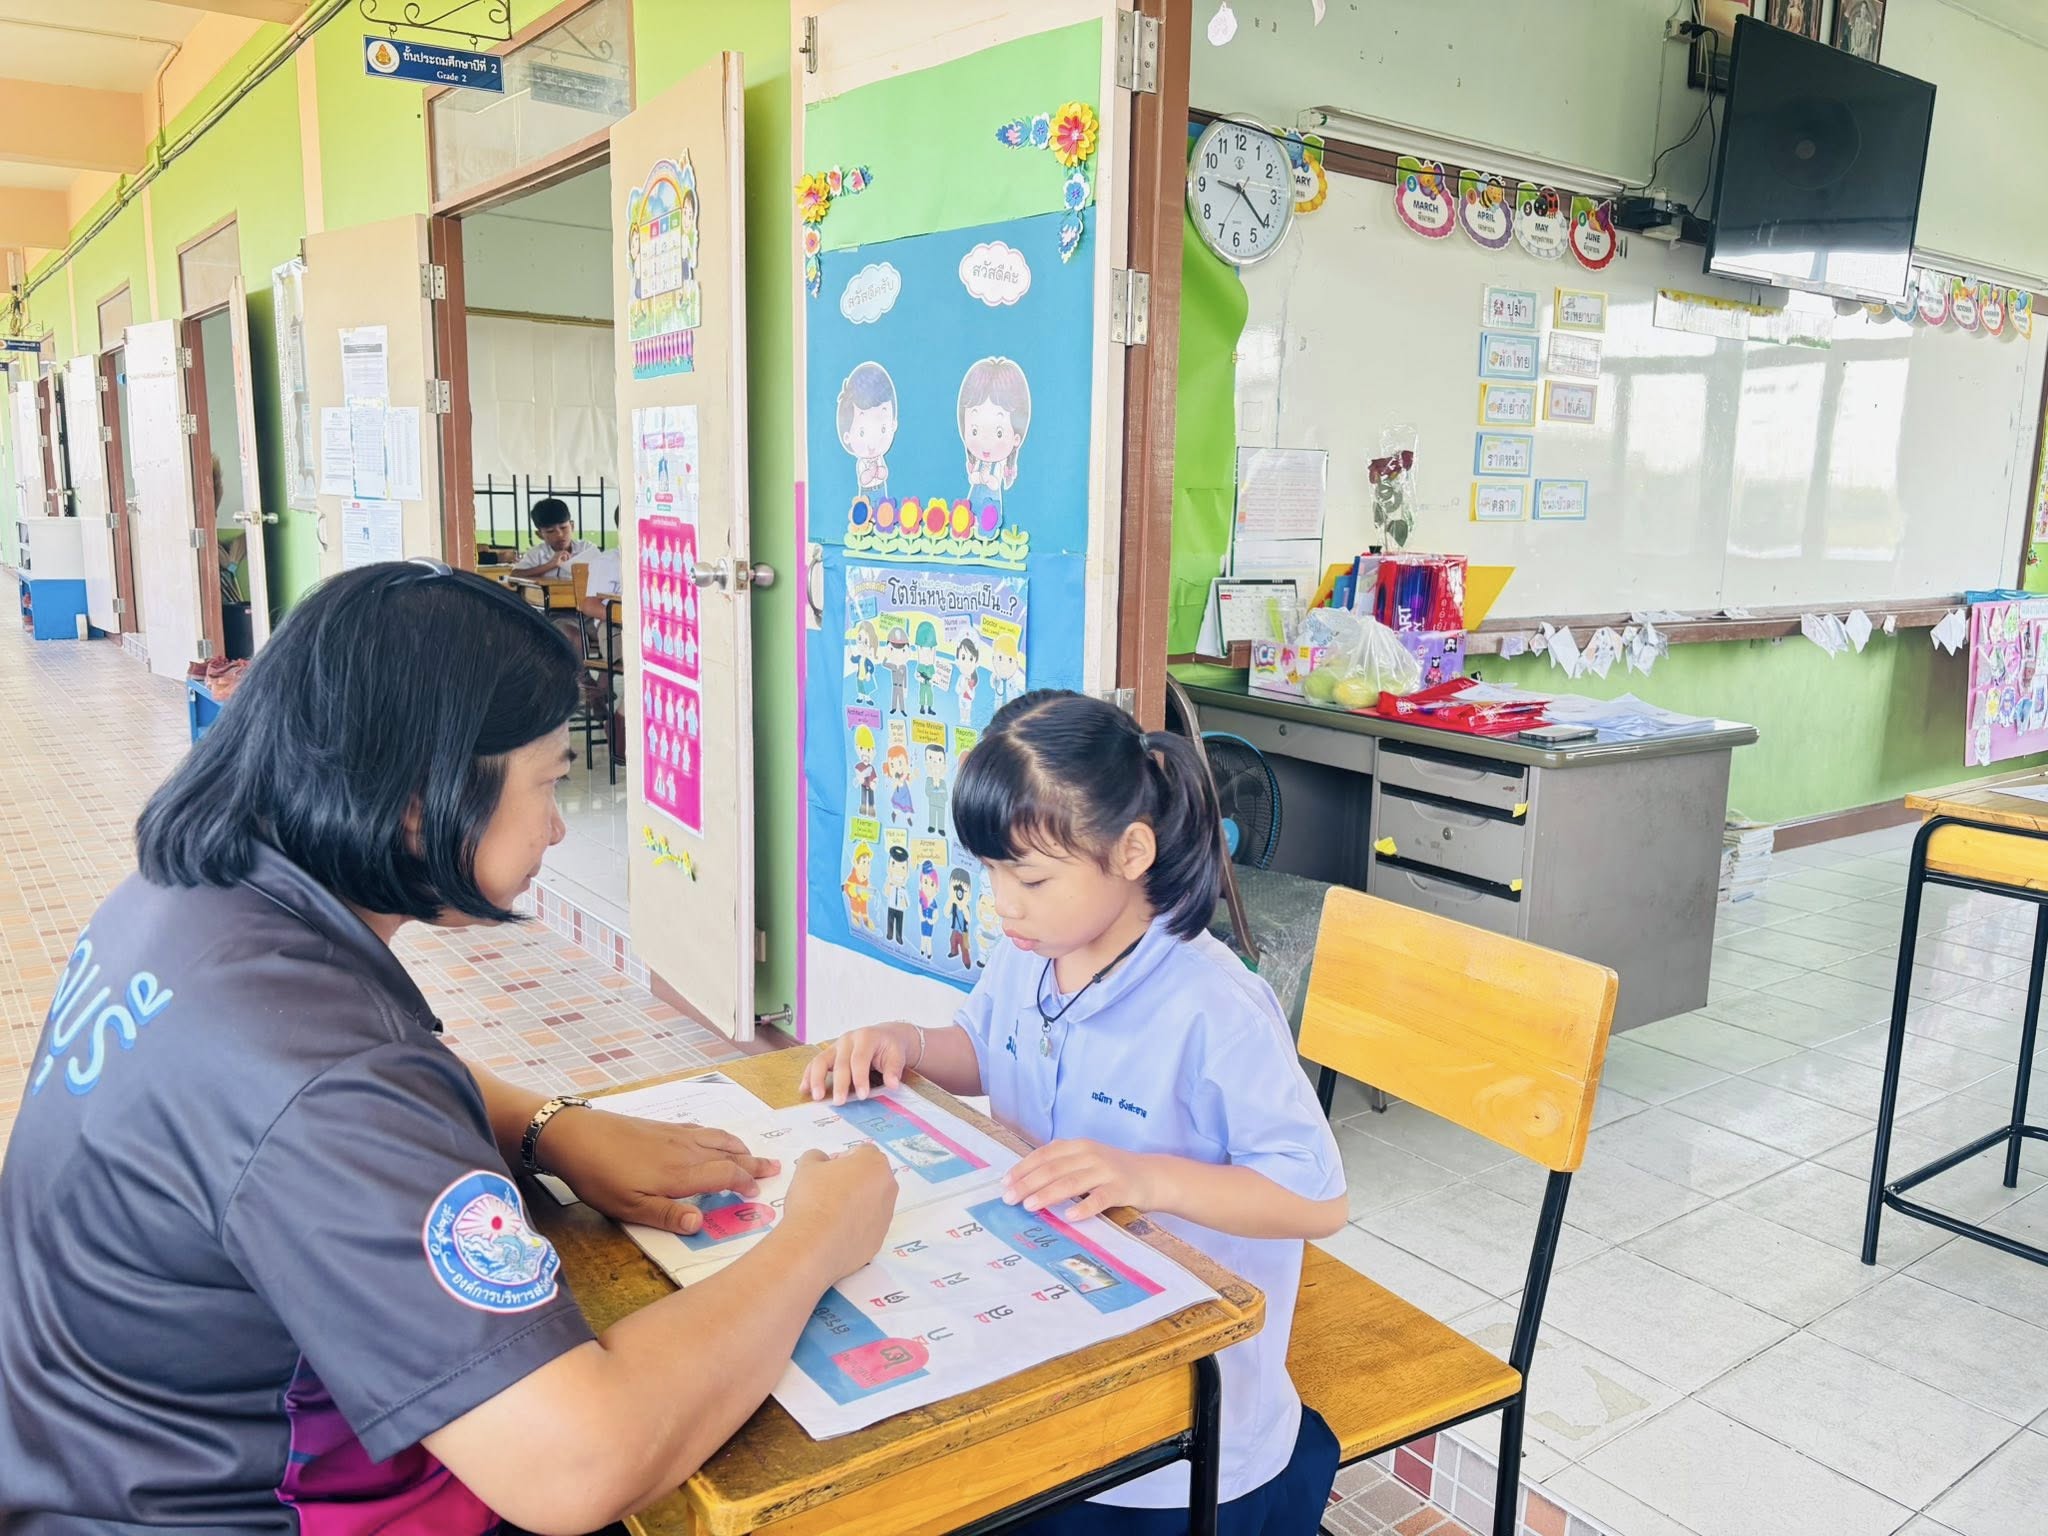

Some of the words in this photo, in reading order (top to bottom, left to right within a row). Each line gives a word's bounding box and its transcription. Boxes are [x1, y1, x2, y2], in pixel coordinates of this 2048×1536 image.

[402, 45, 487, 72] ชั้นประถมศึกษาปีที่
[490, 63, 497, 74] 2
[436, 70, 459, 82] Grade
[461, 74, 468, 83] 2
[1218, 138, 1228, 154] 11
[1235, 134, 1247, 151] 12
[1255, 145, 1261, 160] 1
[1206, 153, 1218, 169] 10
[1266, 164, 1273, 179] 2
[1198, 177, 1206, 192] 9
[1270, 190, 1277, 205] 3
[1203, 204, 1211, 219] 8
[1412, 200, 1439, 214] MARCH
[1263, 214, 1270, 228] 4
[1477, 210, 1496, 223] APRIL
[1218, 223, 1225, 238] 7
[1535, 222, 1549, 232] MAY
[1233, 232, 1240, 247] 6
[1250, 228, 1257, 243] 5
[1585, 231, 1601, 243] JUNE
[972, 260, 1020, 285] สวัสดีค่ะ
[848, 277, 895, 308] สวัสดีครับ
[1507, 298, 1528, 325] ปูม้า
[1487, 448, 1523, 467] ราดหน้า
[1491, 499, 1516, 513] ตลาด
